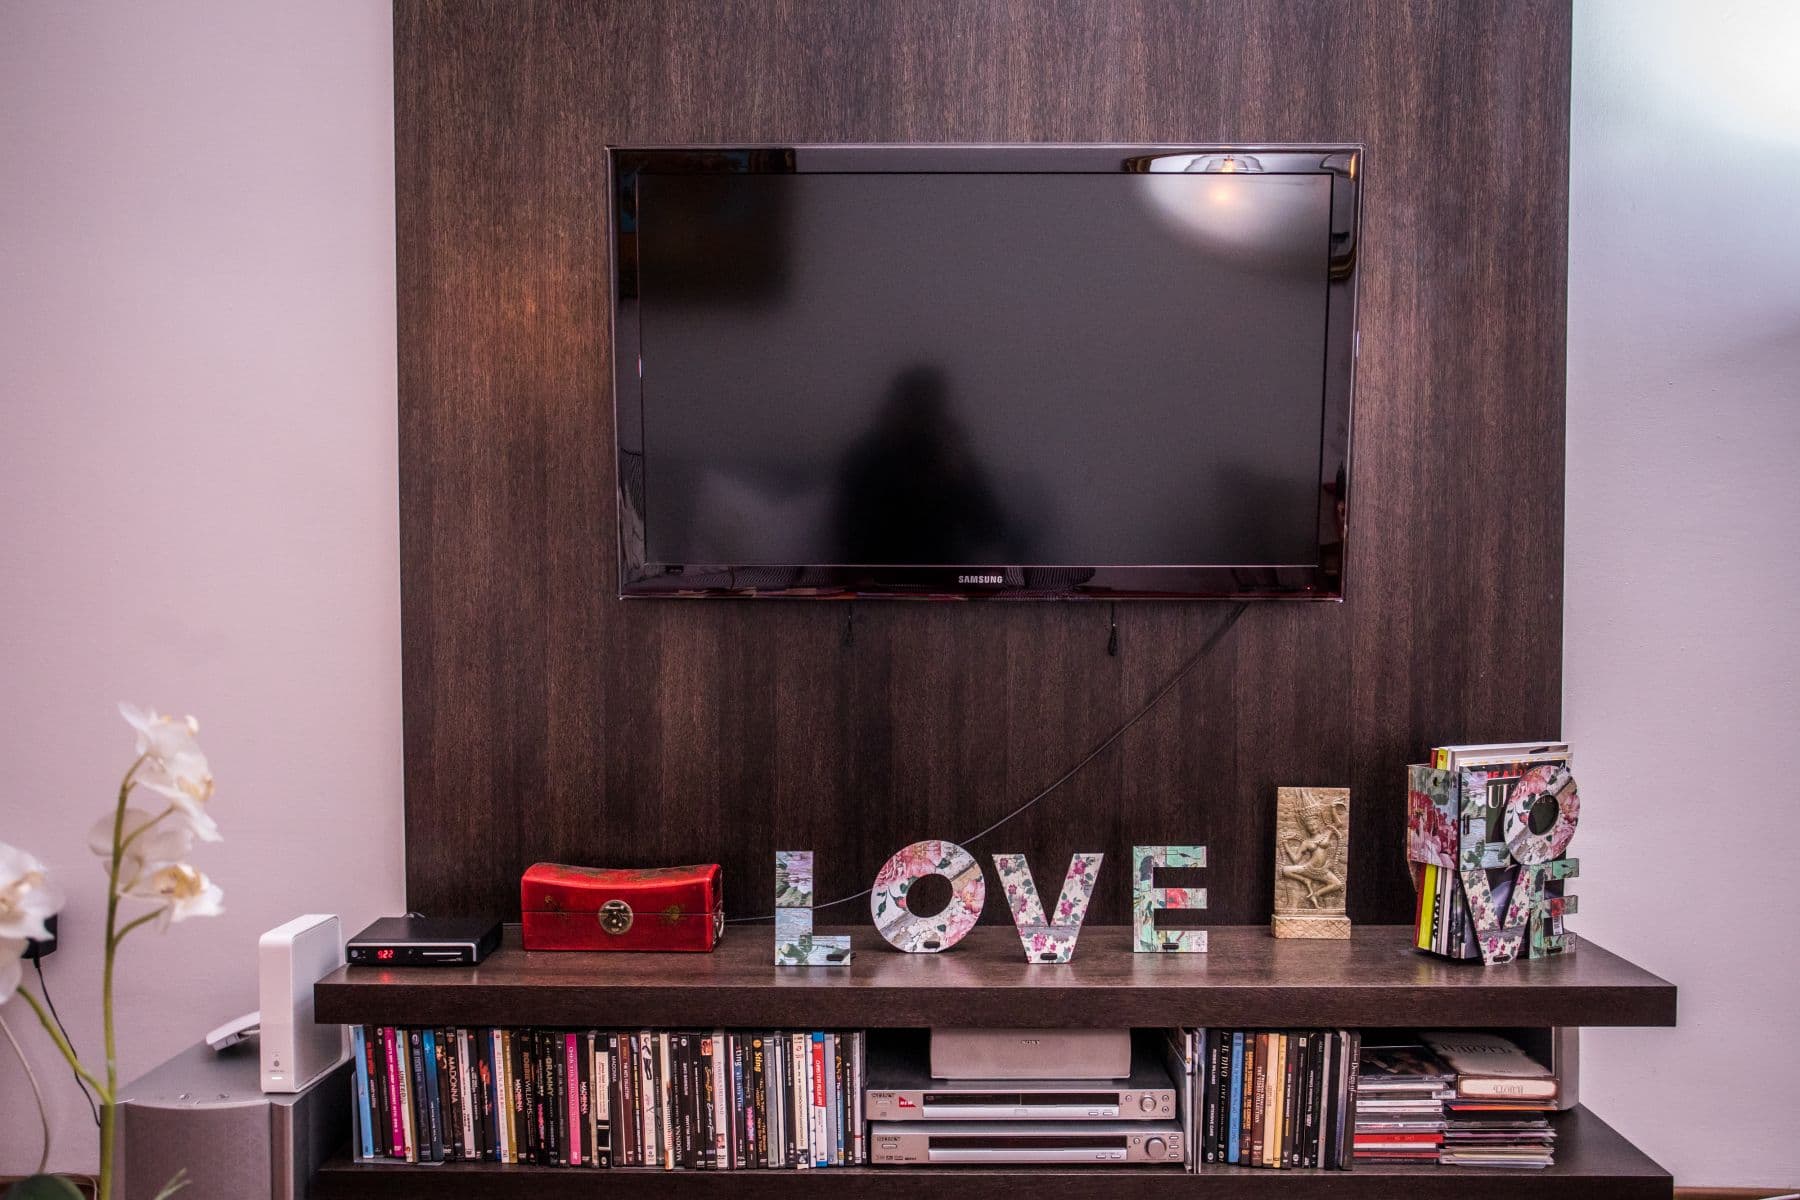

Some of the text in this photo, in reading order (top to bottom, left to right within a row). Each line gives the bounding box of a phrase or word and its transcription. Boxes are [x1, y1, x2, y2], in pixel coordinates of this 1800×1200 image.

[958, 575, 1003, 584] SAMSUNG
[774, 839, 1208, 966] LOVE
[753, 1051, 763, 1073] Sting
[1221, 1045, 1229, 1053] IL
[448, 1056, 459, 1104] MADONNA
[545, 1057, 554, 1096] GRAMMY
[1349, 1062, 1359, 1085] Design
[515, 1079, 523, 1113] MADONNA
[524, 1079, 533, 1115] WILLIAMS
[580, 1081, 588, 1114] MADONNA
